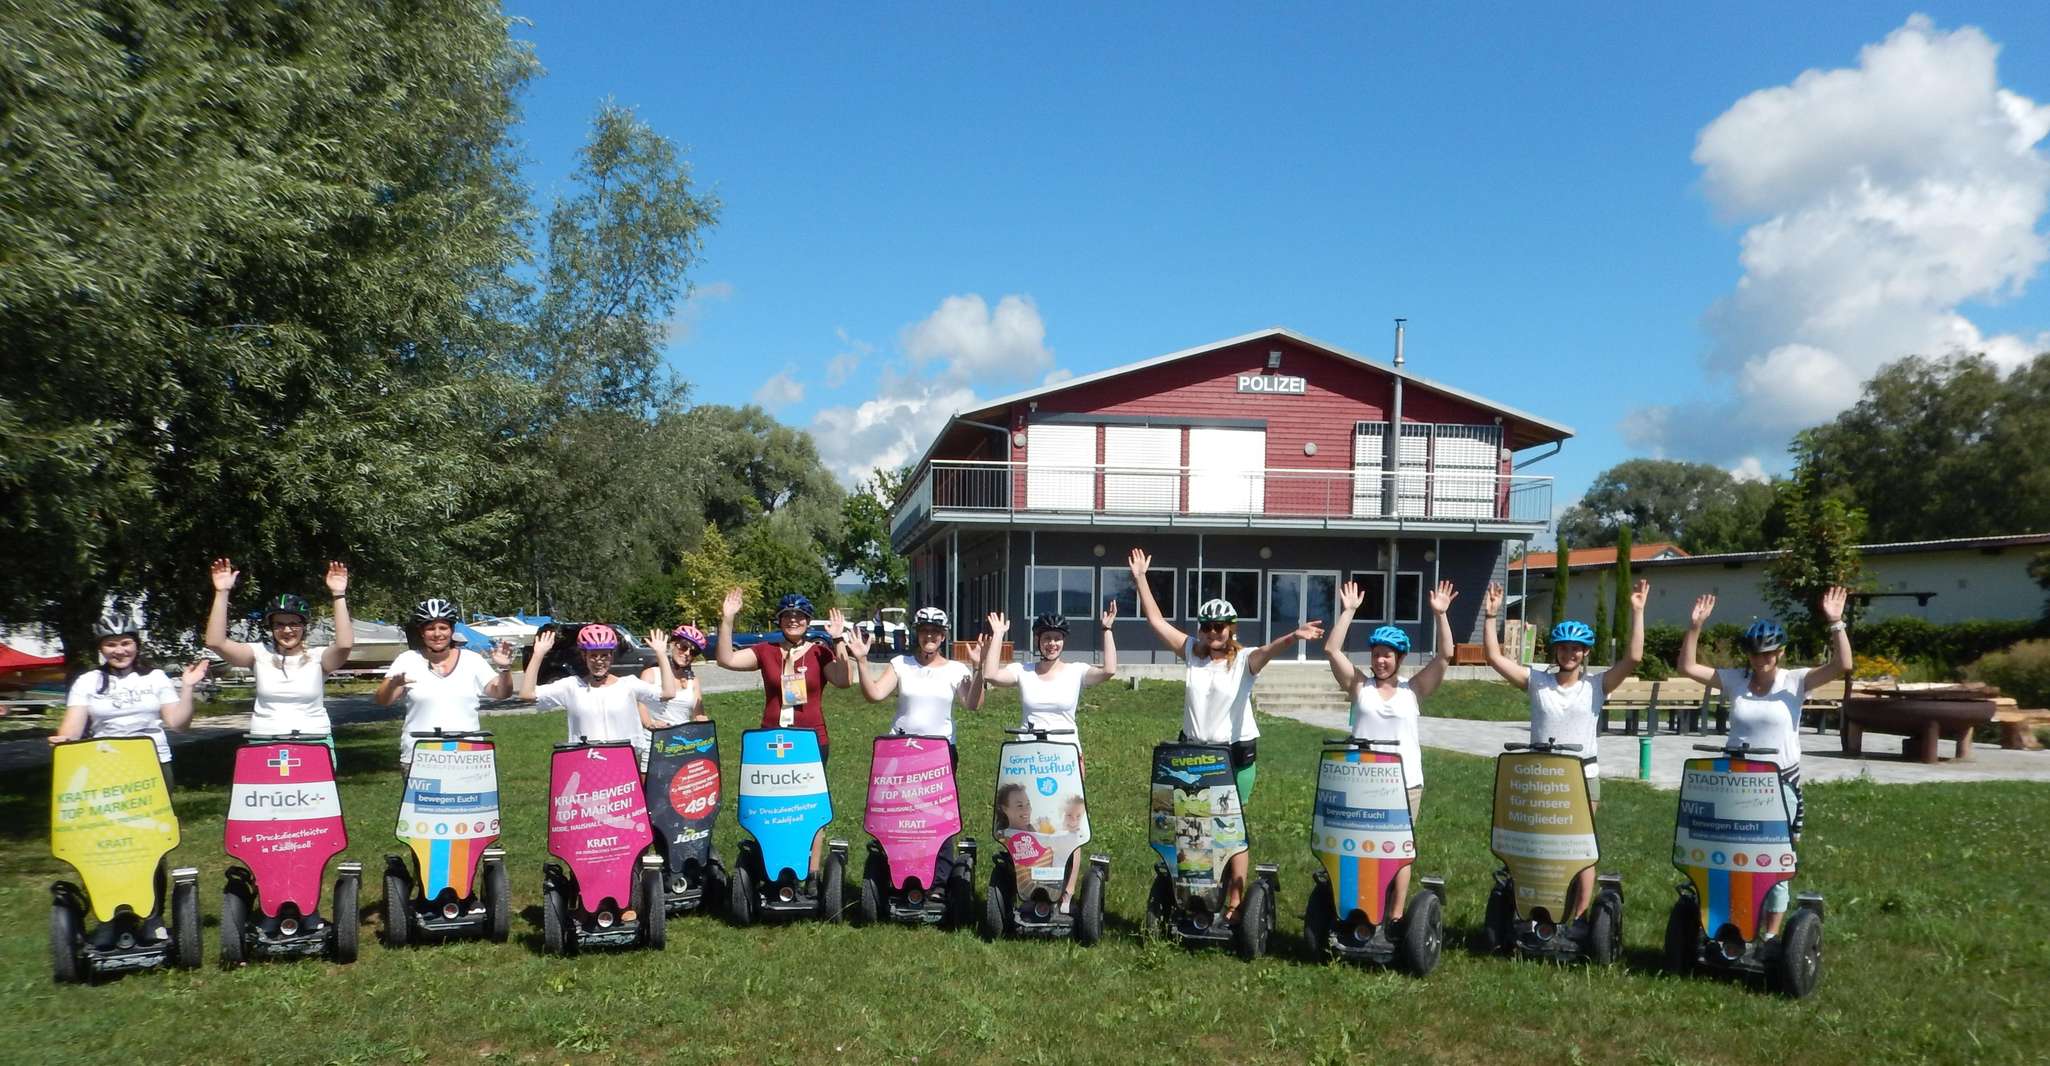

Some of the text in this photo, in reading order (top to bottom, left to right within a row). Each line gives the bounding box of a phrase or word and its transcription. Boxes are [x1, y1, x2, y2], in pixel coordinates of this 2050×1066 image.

[1239, 377, 1305, 392] POLIZEI
[417, 753, 492, 765] STADTWERKE
[1039, 754, 1060, 762] Euch
[1030, 760, 1075, 776] Ausflug!
[1323, 764, 1400, 777] STADTWERKE
[1514, 763, 1566, 776] Goldene
[874, 765, 950, 785] KRATT BEWEGT!
[1688, 774, 1775, 787] STADTWERKE
[58, 777, 161, 803] KRATT BEWEGT
[408, 780, 432, 791] Wir
[880, 782, 944, 800] TOP MARKEN
[1510, 780, 1570, 796] Highlights
[418, 794, 478, 804] bewegen Euch!
[554, 781, 637, 807] KRATT BEWEGT
[1319, 792, 1337, 803] Wir
[1510, 796, 1570, 808] für unsere
[1681, 801, 1704, 815] Wir
[60, 807, 85, 820] TOP
[558, 797, 632, 821] TOP MARKEN!
[1326, 808, 1385, 819] bewegen Euch!
[898, 820, 926, 829] KRATT
[1509, 811, 1574, 826] Mitglieder!
[1692, 820, 1759, 831] bewegen Euch!
[97, 837, 133, 848] KRATT
[586, 836, 618, 848] KRATT
